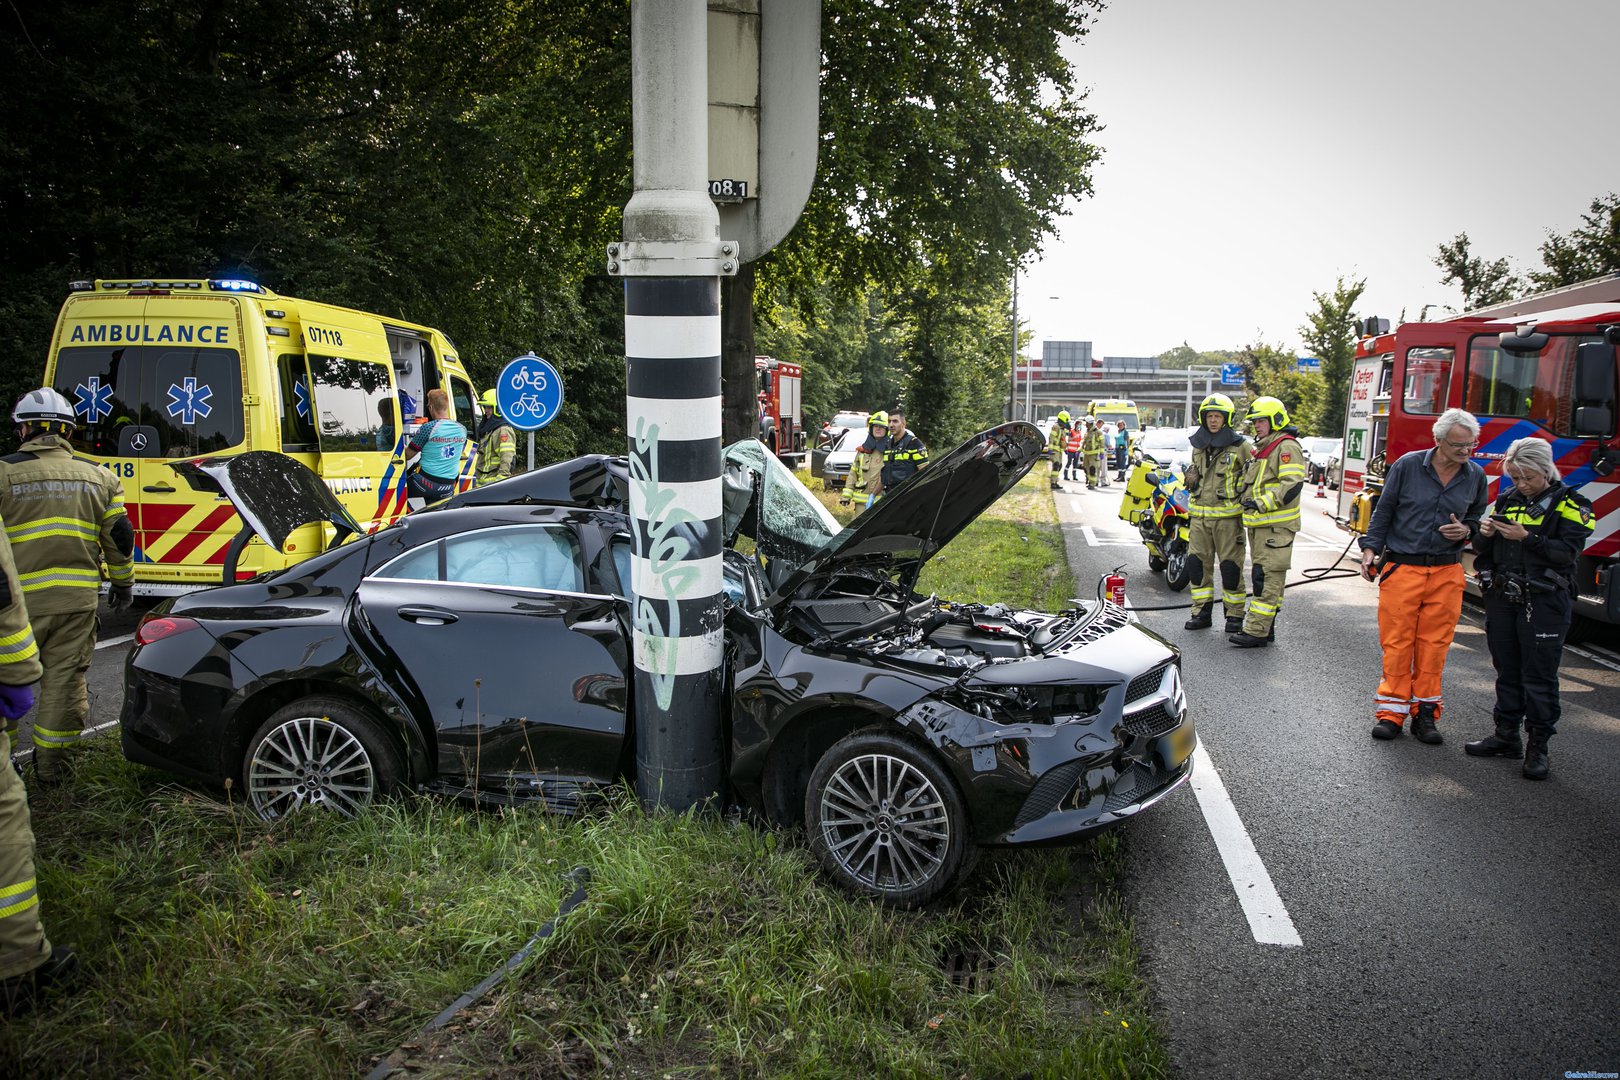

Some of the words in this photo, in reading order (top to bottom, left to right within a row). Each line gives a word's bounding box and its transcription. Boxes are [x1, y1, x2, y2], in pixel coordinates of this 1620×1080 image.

[707, 180, 746, 196] 08.1
[70, 324, 229, 343] AMBULANCE
[308, 326, 343, 347] 07118
